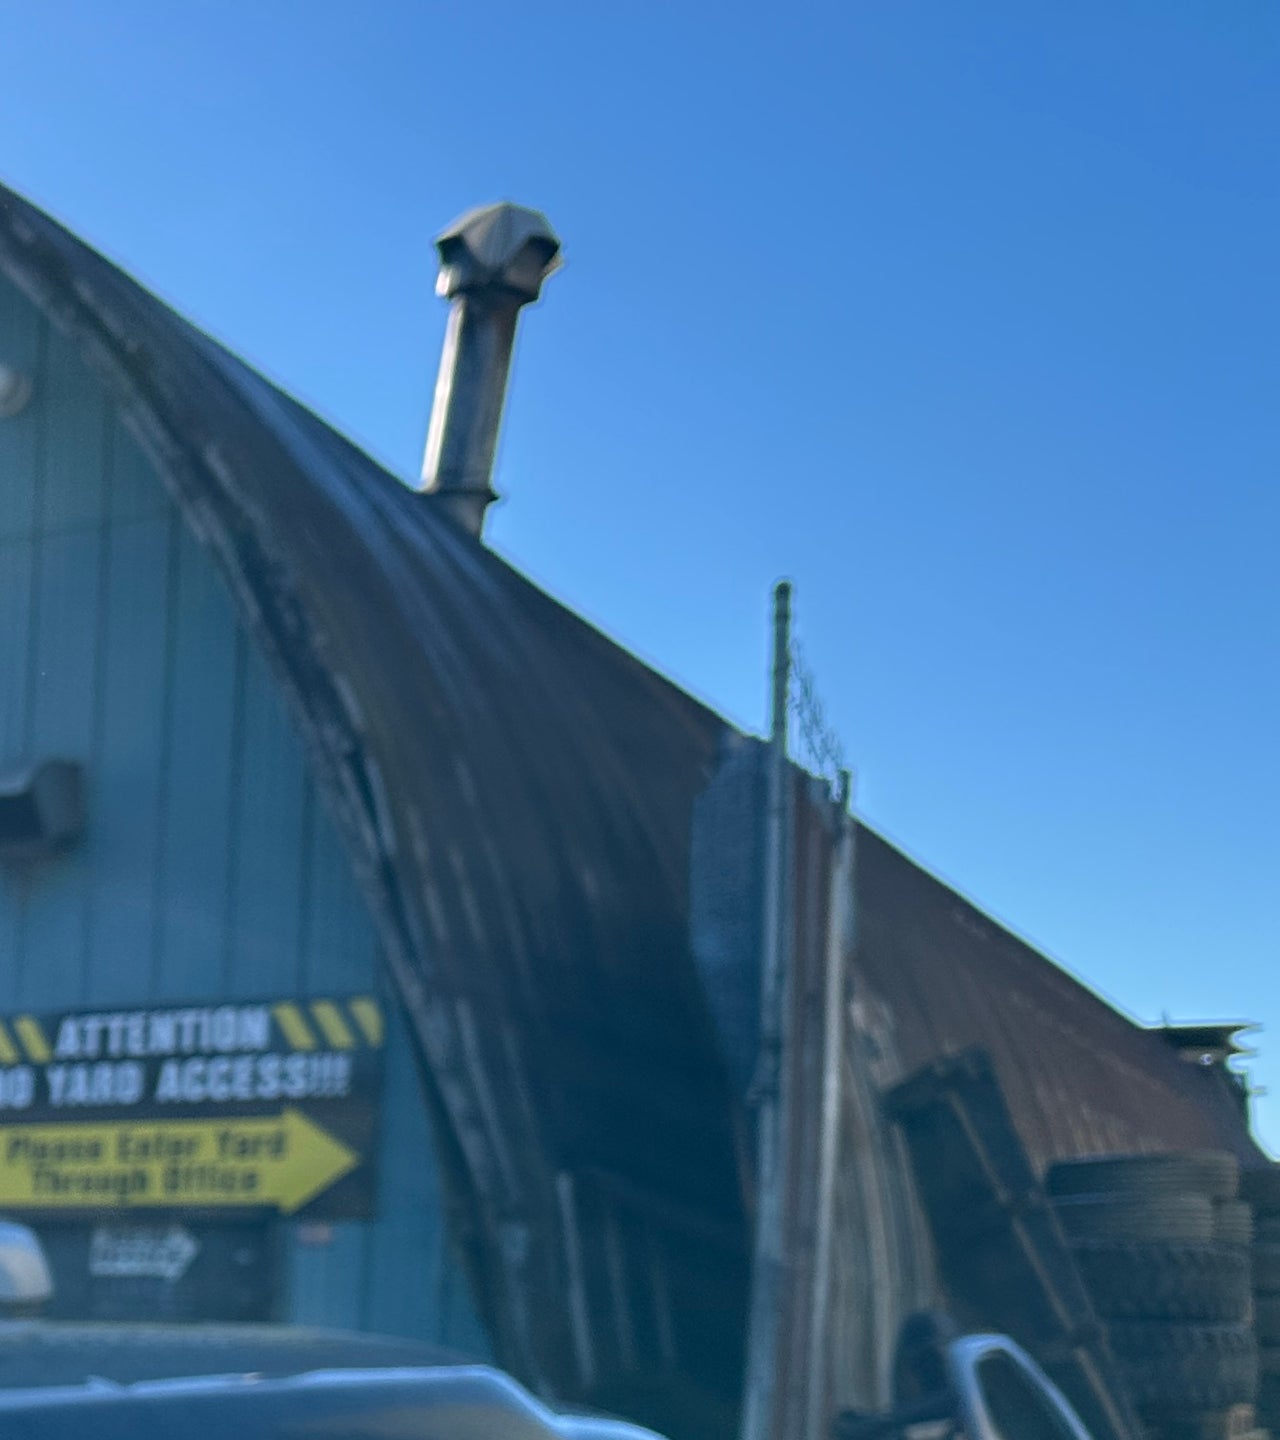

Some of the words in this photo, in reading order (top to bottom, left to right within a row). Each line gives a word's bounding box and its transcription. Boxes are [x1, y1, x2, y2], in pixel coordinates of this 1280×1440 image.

[55, 1004, 270, 1057] ATTENTION
[45, 1062, 143, 1105] YARD
[155, 1053, 352, 1103] ACCESS!!!
[7, 1132, 103, 1166] Please
[117, 1130, 198, 1163] Enter
[215, 1128, 287, 1162] Yard
